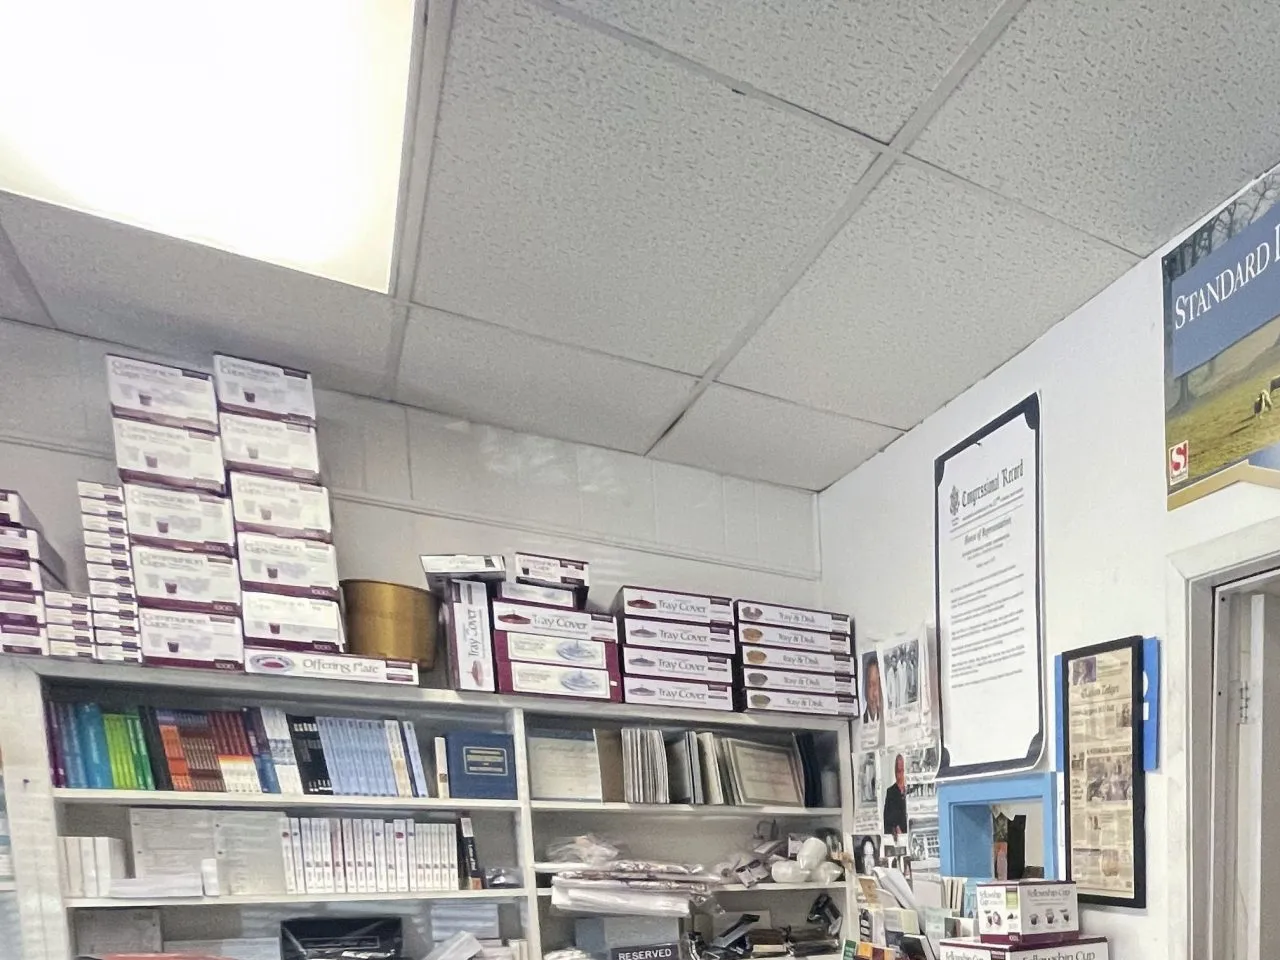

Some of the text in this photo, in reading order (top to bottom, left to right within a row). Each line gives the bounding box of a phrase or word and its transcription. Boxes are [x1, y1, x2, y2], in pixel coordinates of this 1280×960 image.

[1175, 241, 1270, 329] STANDARD
[658, 600, 706, 614] Tray Cover
[532, 614, 587, 631] Tray Cover
[466, 607, 478, 657] Tray Cover
[660, 630, 708, 643] Tray Cover
[303, 659, 351, 673] Offering
[658, 658, 705, 672] Tray Cover
[658, 687, 705, 701] Tray Cover
